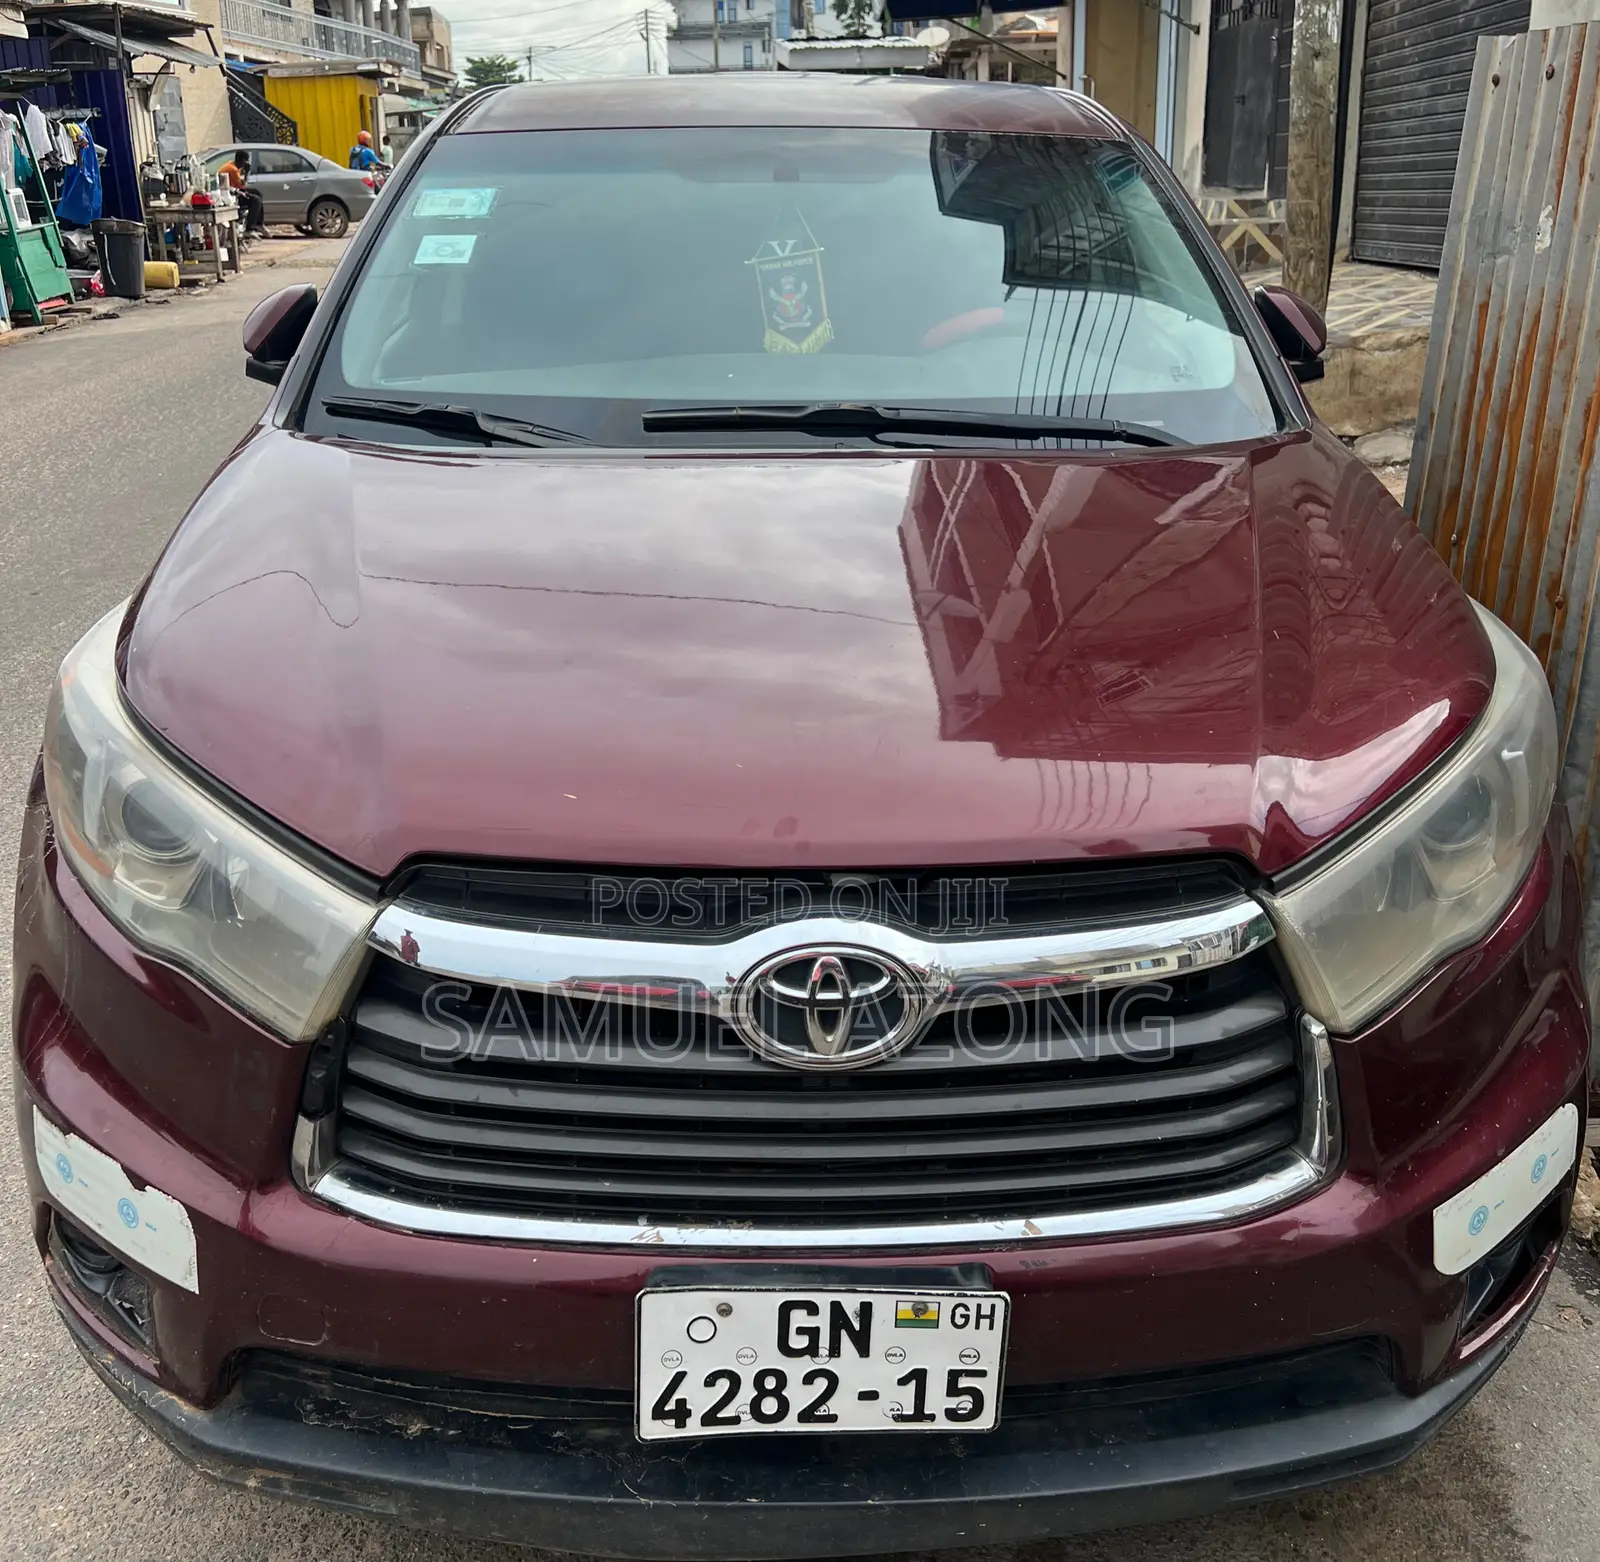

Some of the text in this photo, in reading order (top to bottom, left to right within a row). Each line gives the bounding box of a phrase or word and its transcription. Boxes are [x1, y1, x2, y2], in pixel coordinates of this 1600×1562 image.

[776, 1299, 873, 1358] GN
[949, 1302, 996, 1330] GH
[651, 1367, 988, 1429] 4282-15
